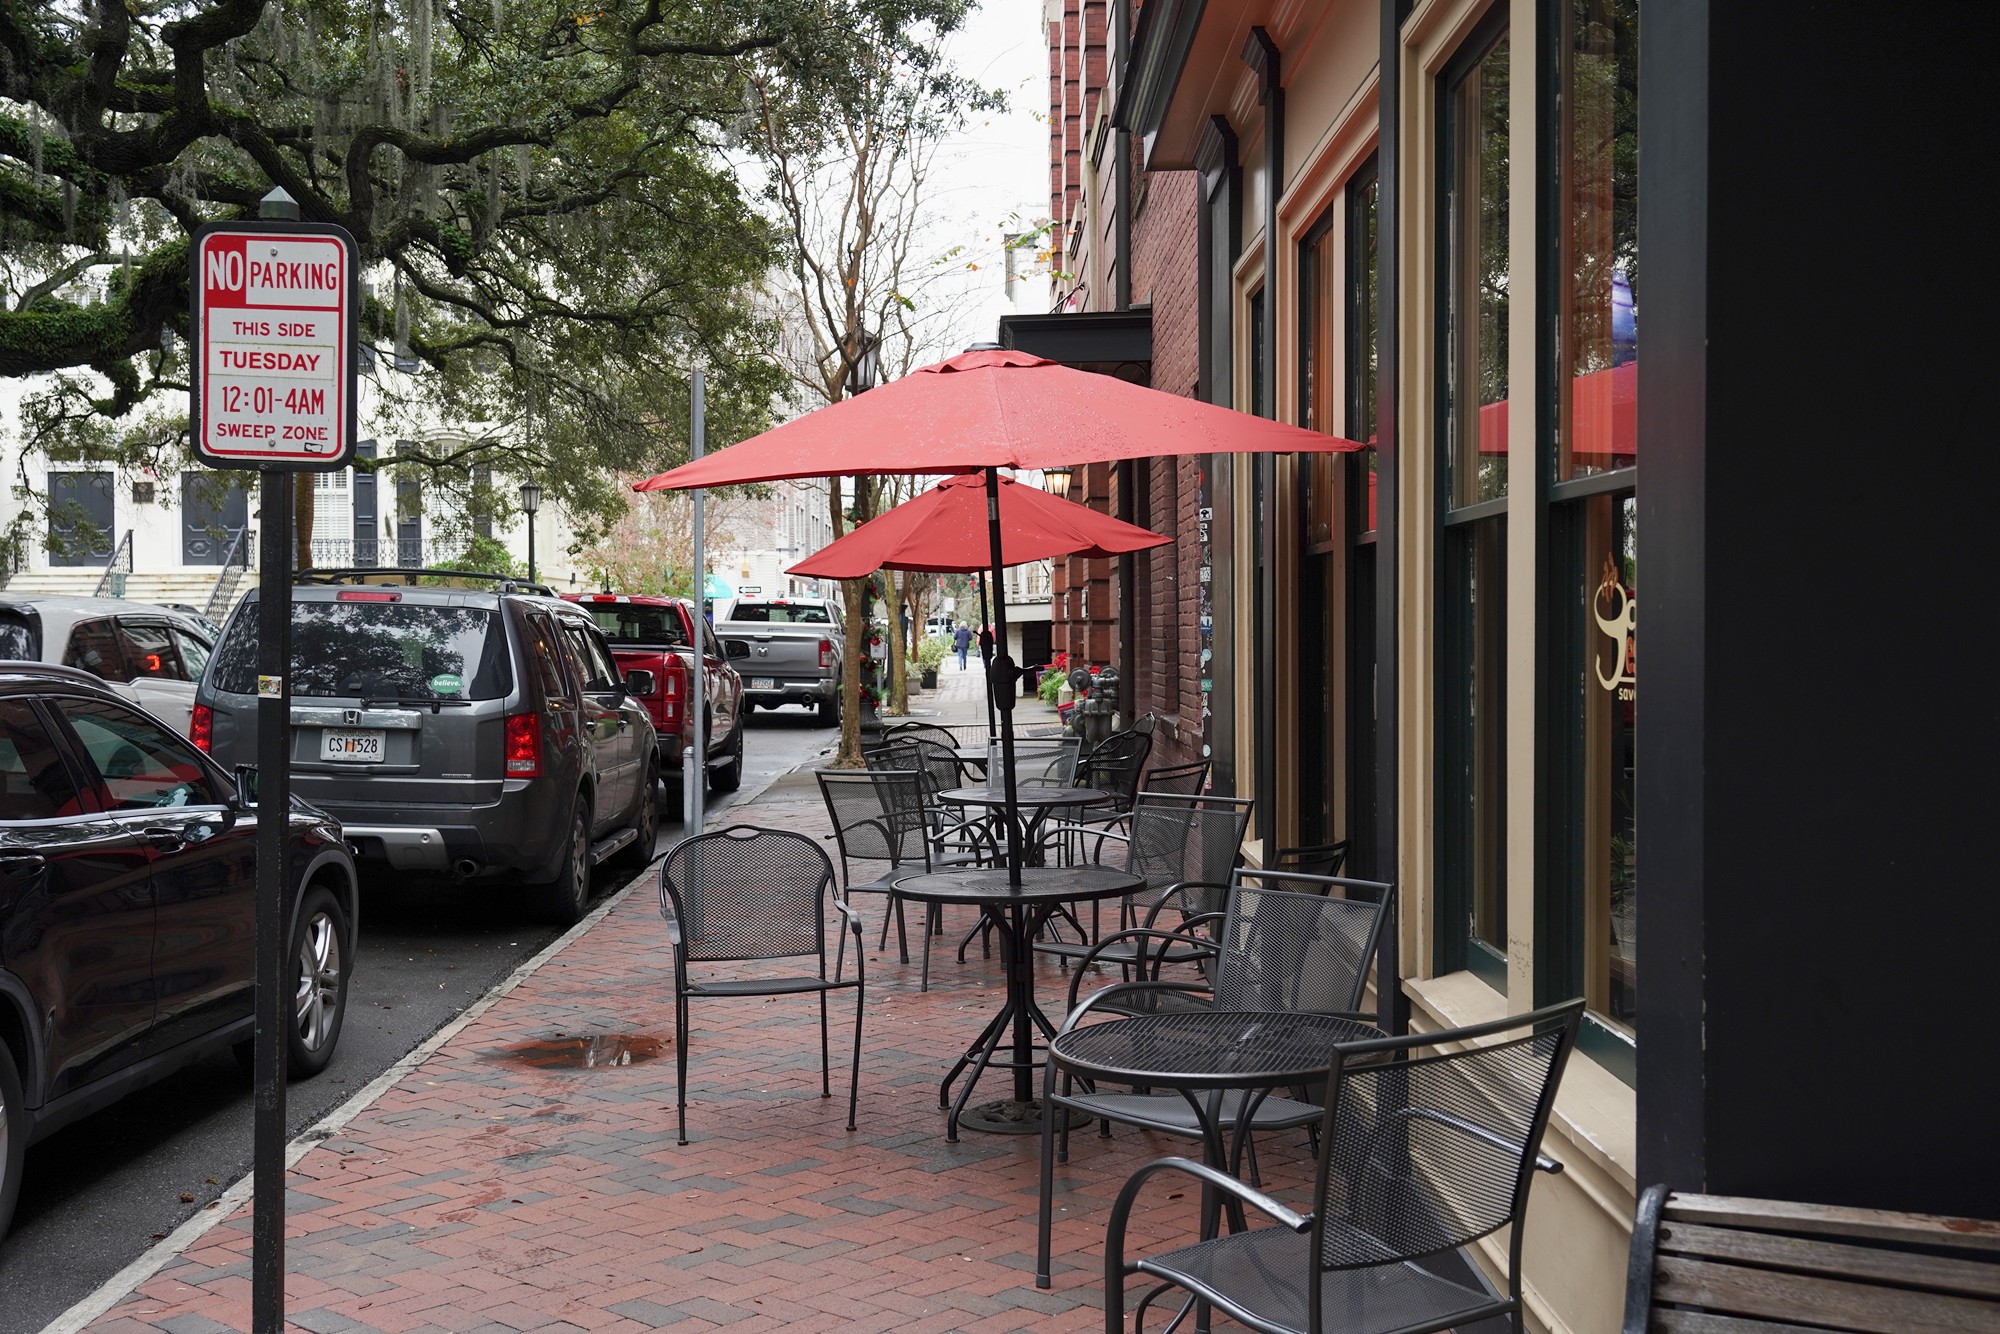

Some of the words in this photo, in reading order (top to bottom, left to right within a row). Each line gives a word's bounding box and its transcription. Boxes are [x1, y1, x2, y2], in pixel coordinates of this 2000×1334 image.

[207, 250, 244, 291] NO
[250, 261, 337, 290] PARKING
[232, 321, 271, 336] THIS
[277, 323, 316, 337] SIDE
[219, 351, 321, 371] TUESDAY
[222, 386, 324, 415] 12:01-4AM
[216, 423, 276, 439] SWEEP
[282, 426, 328, 441] ZONE
